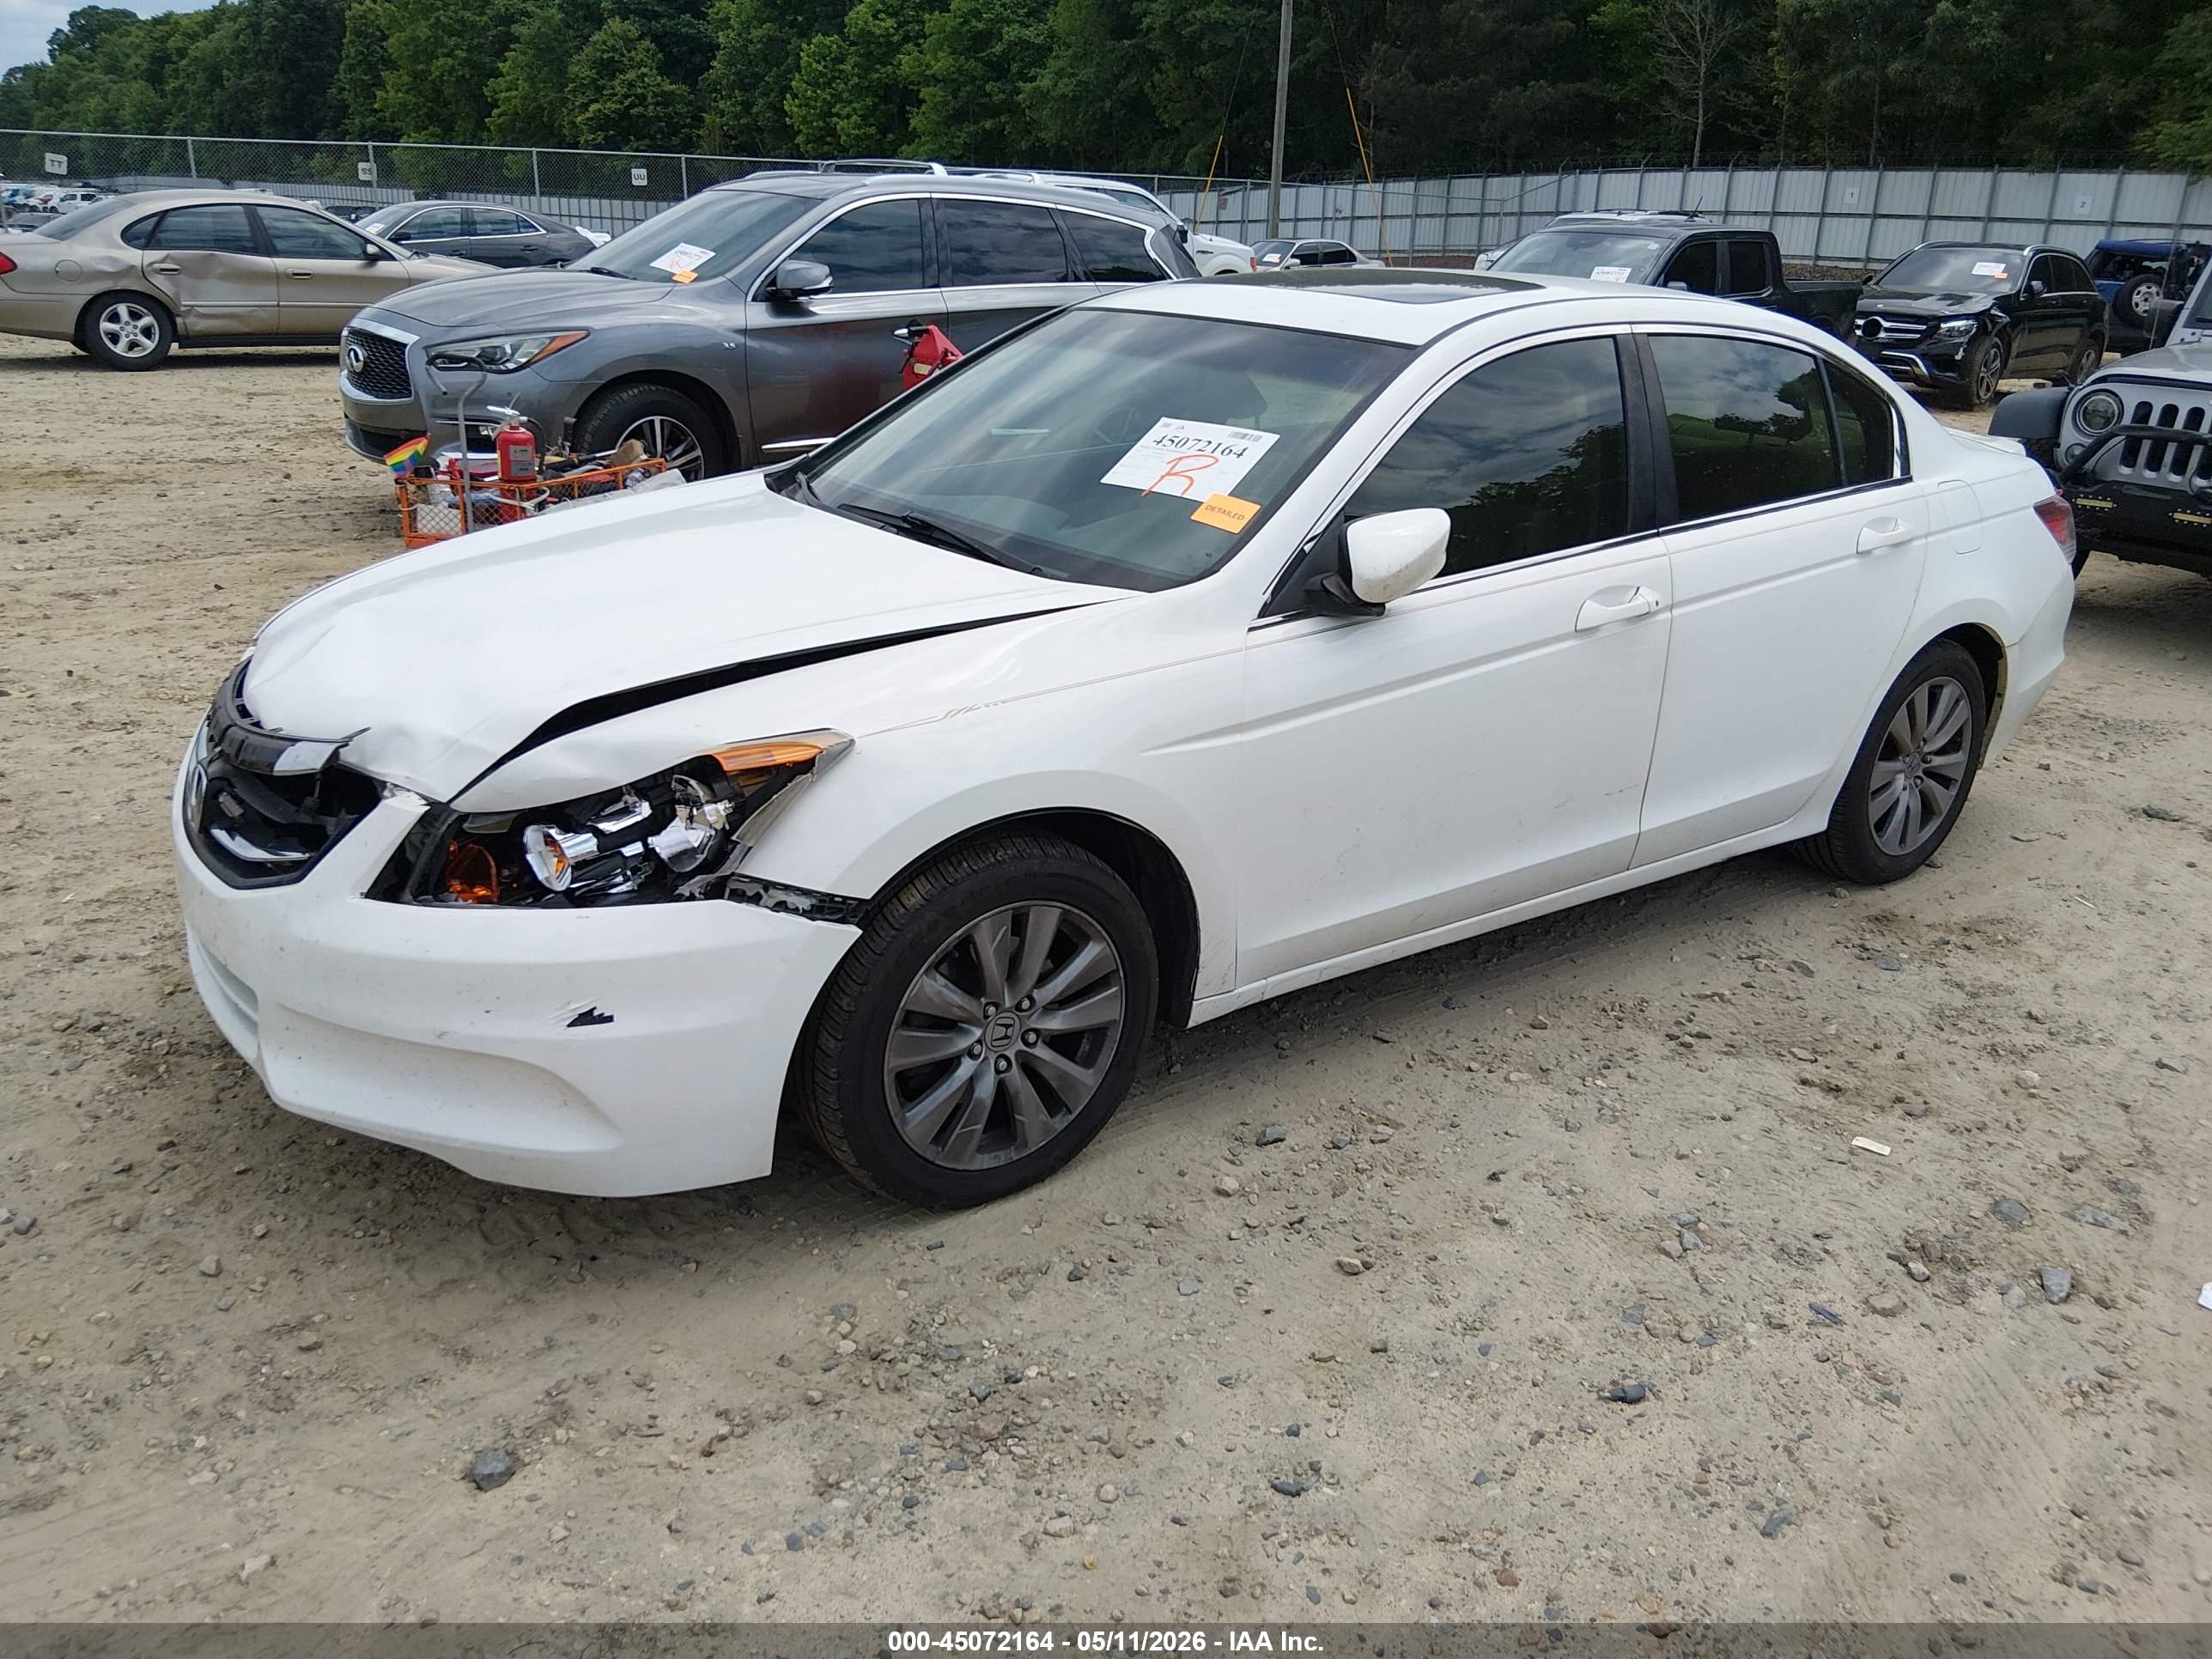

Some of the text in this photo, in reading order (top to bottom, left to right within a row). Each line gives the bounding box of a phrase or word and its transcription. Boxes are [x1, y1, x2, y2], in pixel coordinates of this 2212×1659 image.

[633, 173, 646, 181] UU
[1152, 434, 1249, 459] 45072164
[1204, 504, 1245, 521] DETAILED
